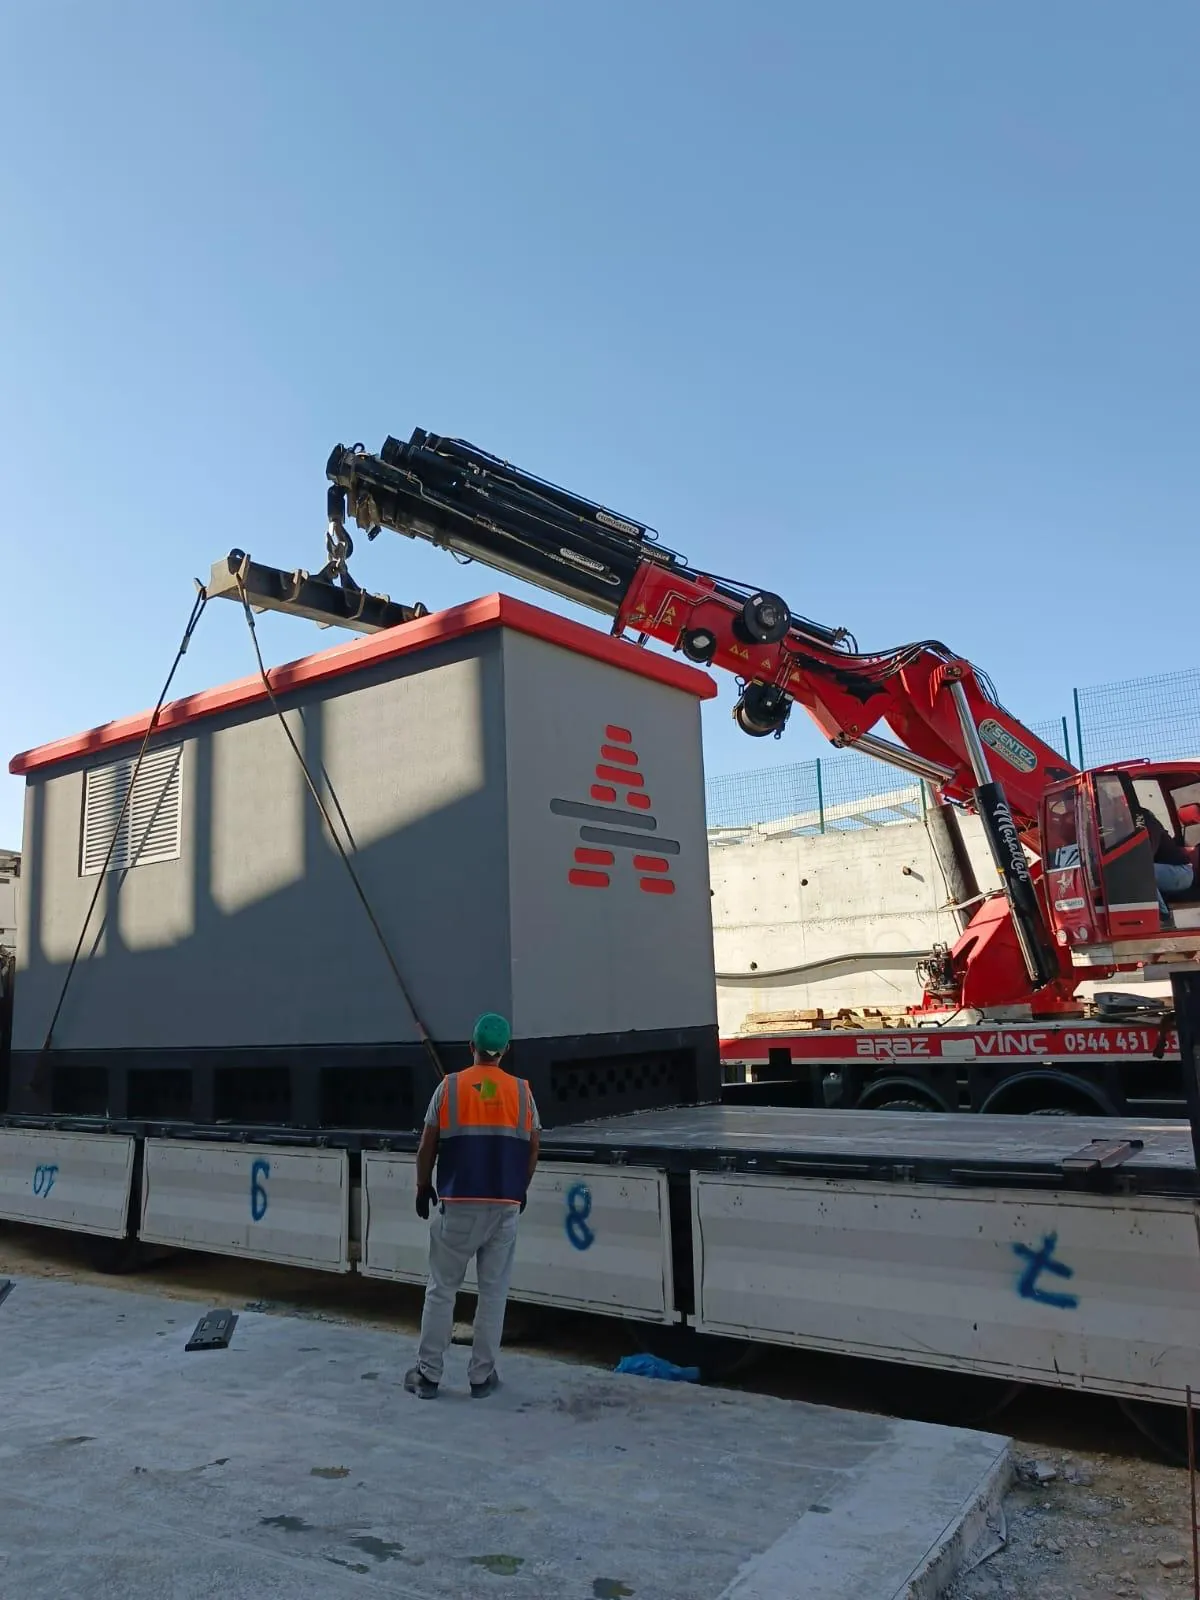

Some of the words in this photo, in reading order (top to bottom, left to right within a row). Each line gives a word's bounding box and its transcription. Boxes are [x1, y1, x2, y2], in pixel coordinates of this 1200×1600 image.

[992, 727, 1034, 765] SENTEZ
[993, 802, 1028, 882] Maşallah
[1064, 1032, 1110, 1051] 0544
[1116, 1031, 1149, 1050] 451
[1158, 1031, 1180, 1050] 3
[565, 1181, 595, 1251] 8
